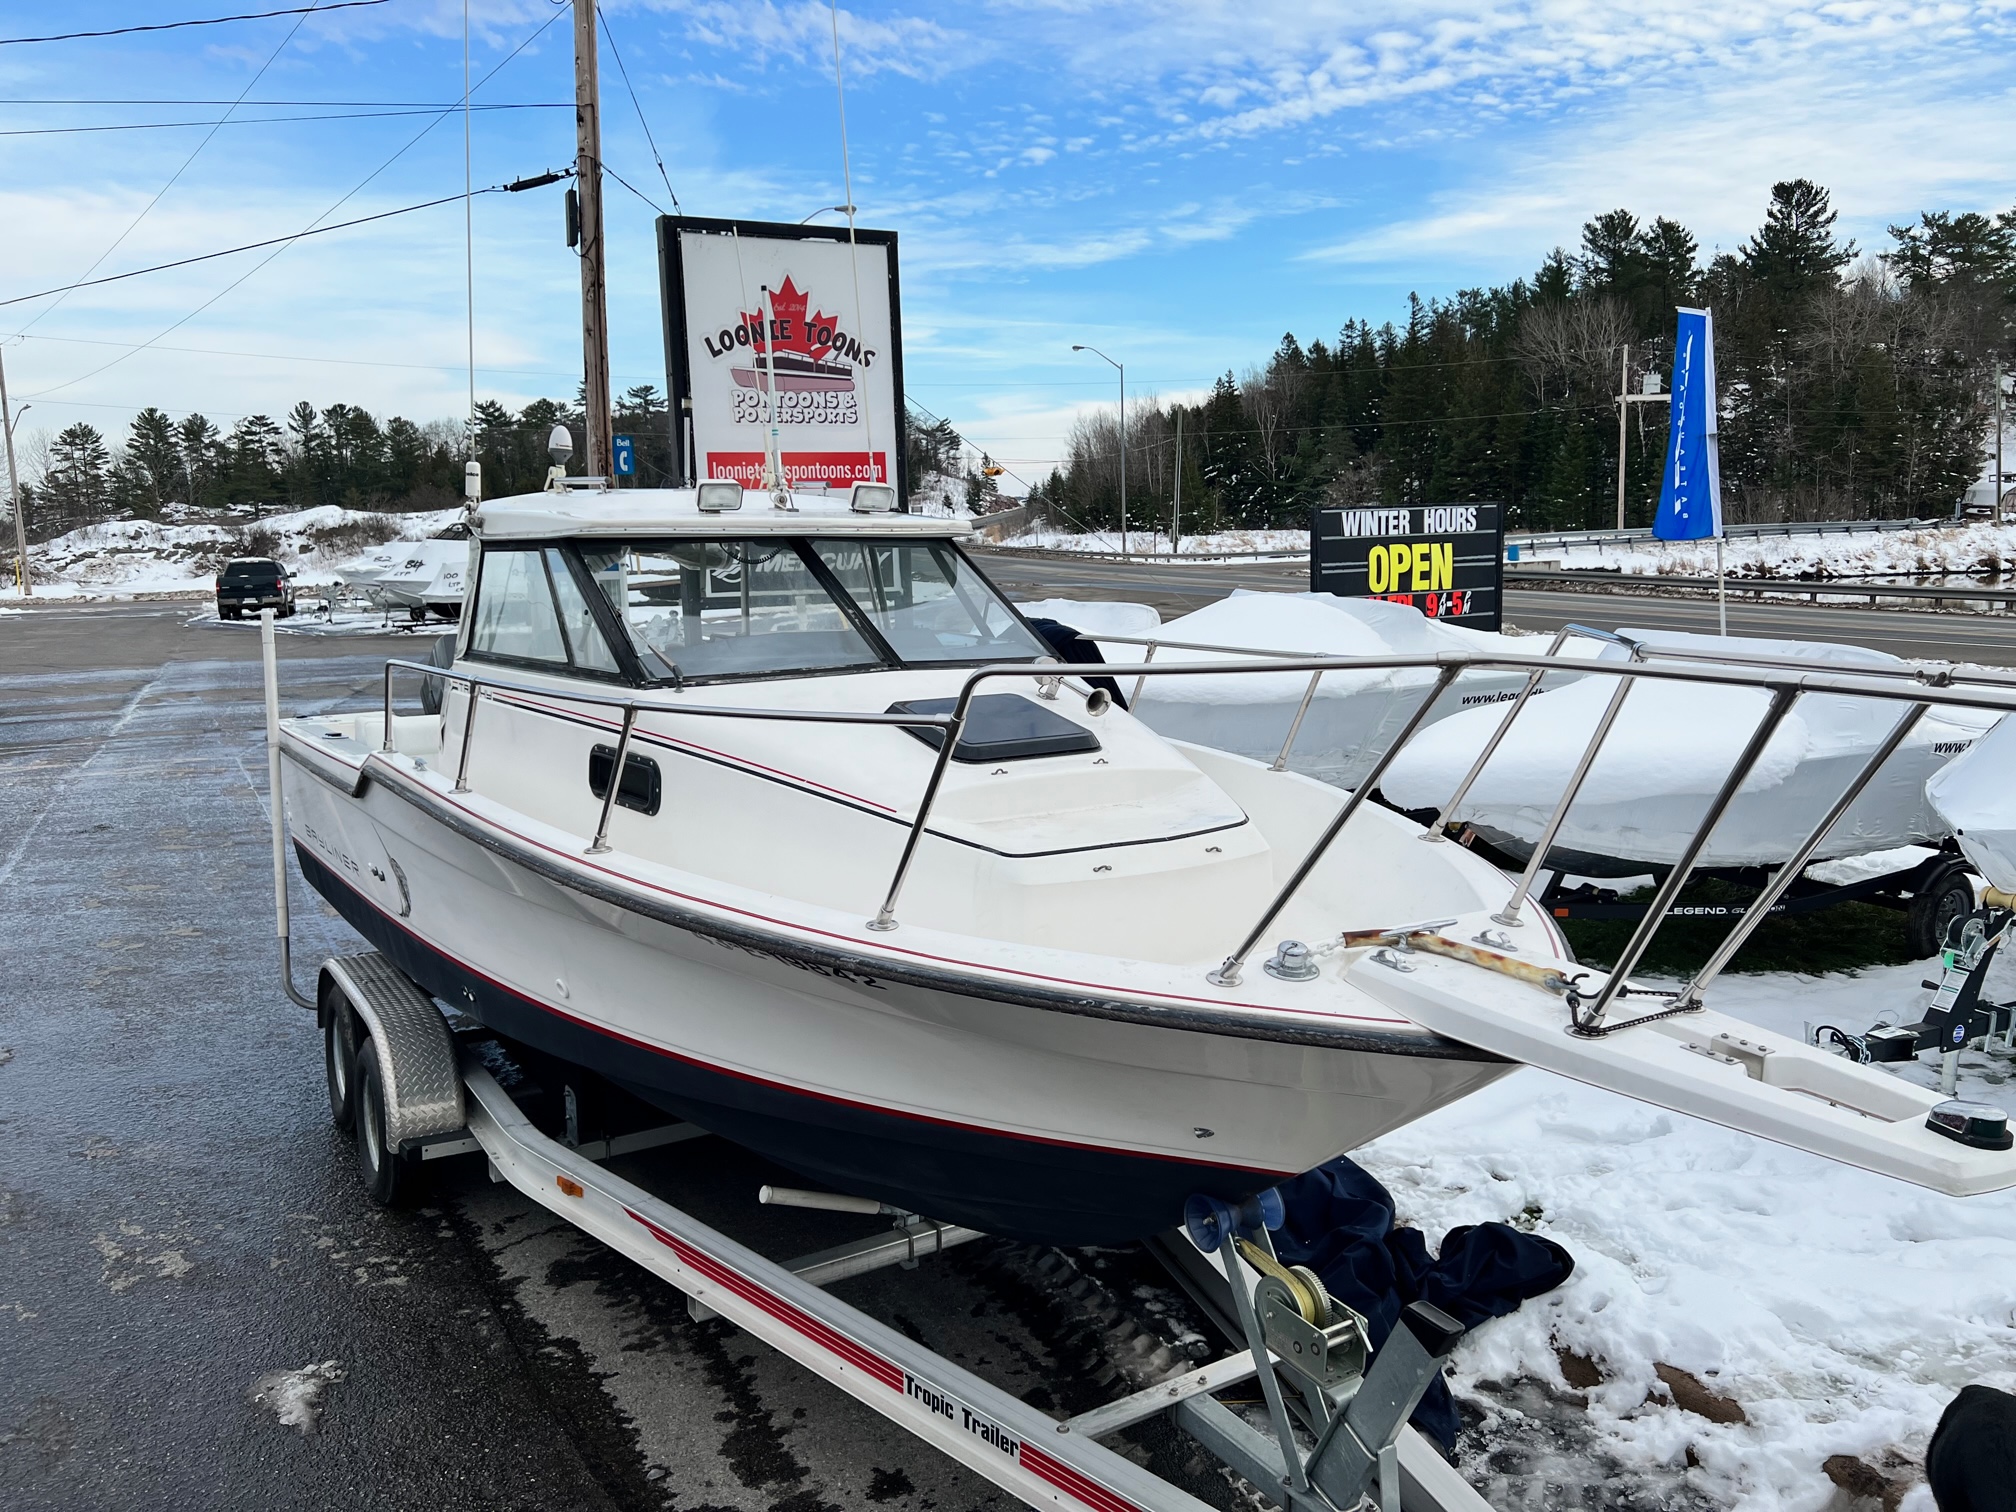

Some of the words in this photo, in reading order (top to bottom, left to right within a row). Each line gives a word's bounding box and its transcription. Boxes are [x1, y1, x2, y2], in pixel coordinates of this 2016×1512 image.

[704, 319, 792, 358] LOONIE
[804, 321, 876, 368] TOONS
[731, 390, 840, 409] PONTOONS
[843, 391, 857, 409] &
[732, 407, 858, 425] POWERSPORTS
[616, 438, 630, 447] Bell
[1341, 509, 1410, 537] WINTER
[1423, 507, 1477, 533] HOURS
[1368, 542, 1453, 593] OPEN
[905, 1373, 954, 1421] Tropic
[961, 1406, 1019, 1458] Trailer
